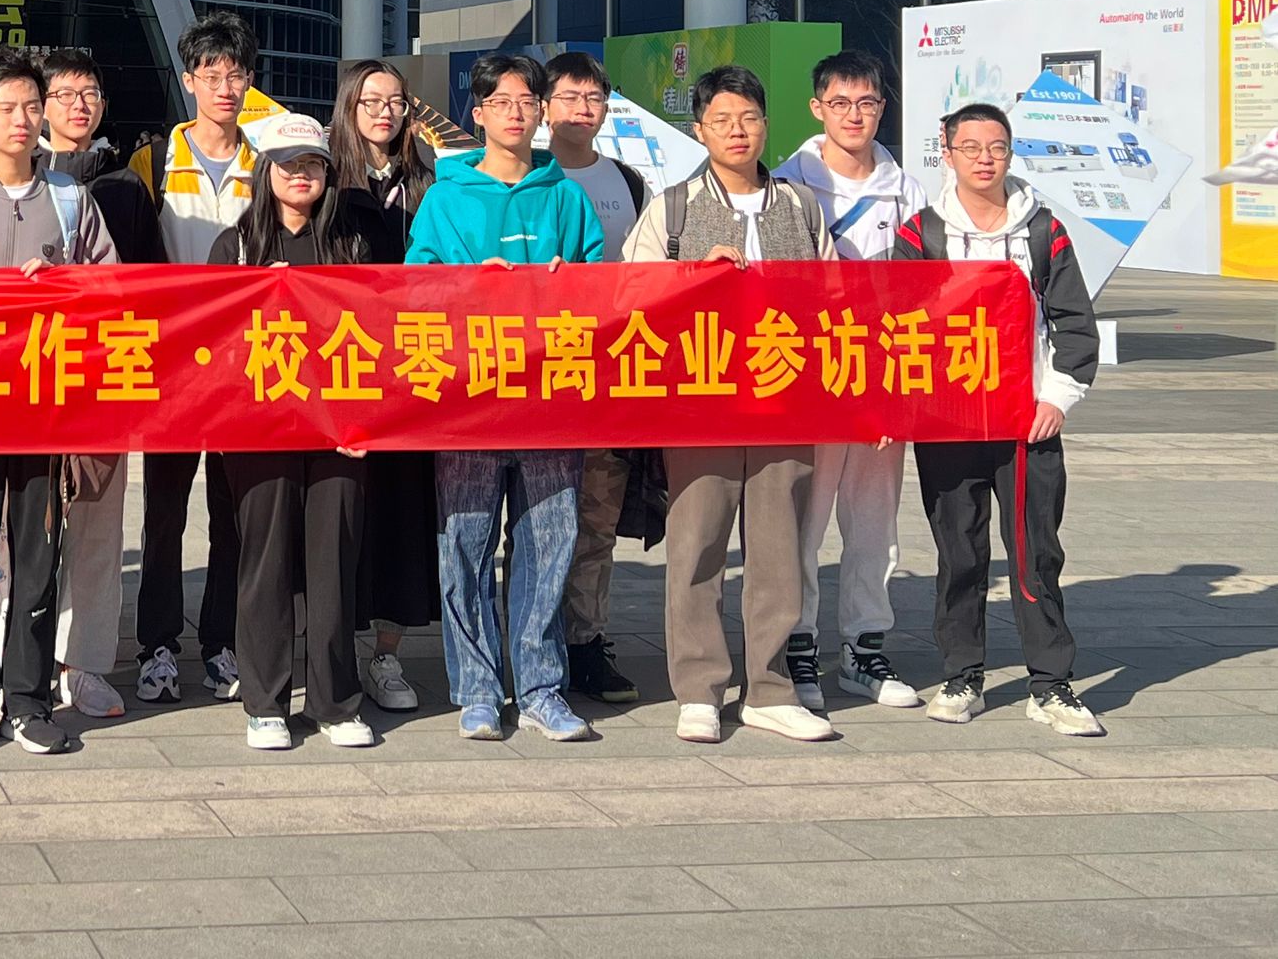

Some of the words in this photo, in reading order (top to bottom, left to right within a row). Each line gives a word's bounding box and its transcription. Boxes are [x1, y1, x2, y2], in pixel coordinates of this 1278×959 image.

[1099, 11, 1145, 24] Automating
[1146, 9, 1158, 20] the
[1160, 7, 1184, 20] World
[1031, 88, 1082, 101] Est.1907
[1024, 112, 1056, 121] JSW
[595, 200, 620, 211] ING
